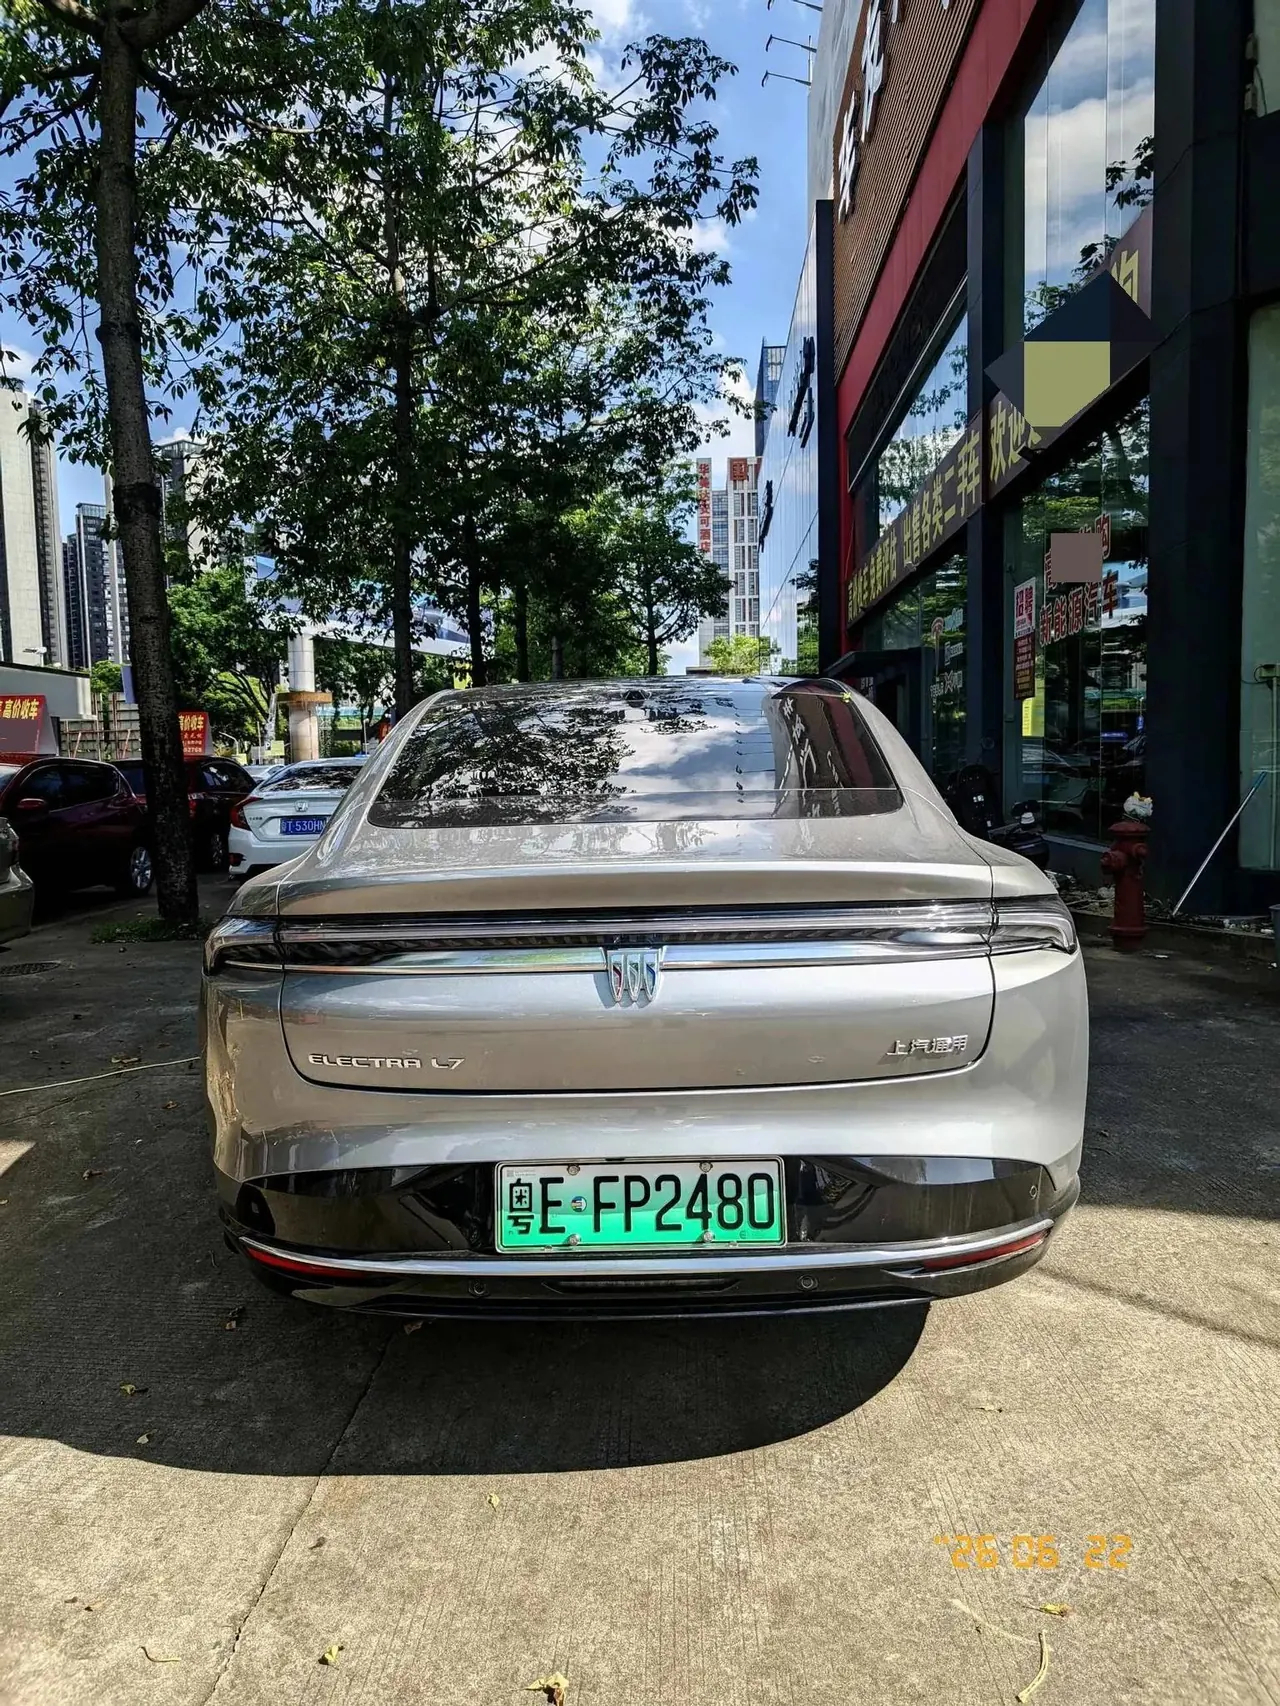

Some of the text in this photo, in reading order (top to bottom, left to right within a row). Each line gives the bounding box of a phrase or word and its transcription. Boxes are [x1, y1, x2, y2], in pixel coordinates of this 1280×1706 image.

[1016, 585, 1034, 619] 招聘
[1040, 569, 1120, 648] 新能源汽车
[3, 698, 40, 720] 高价收车
[886, 1034, 969, 1056] 上汽通用
[308, 1053, 466, 1070] ELECTRA L7
